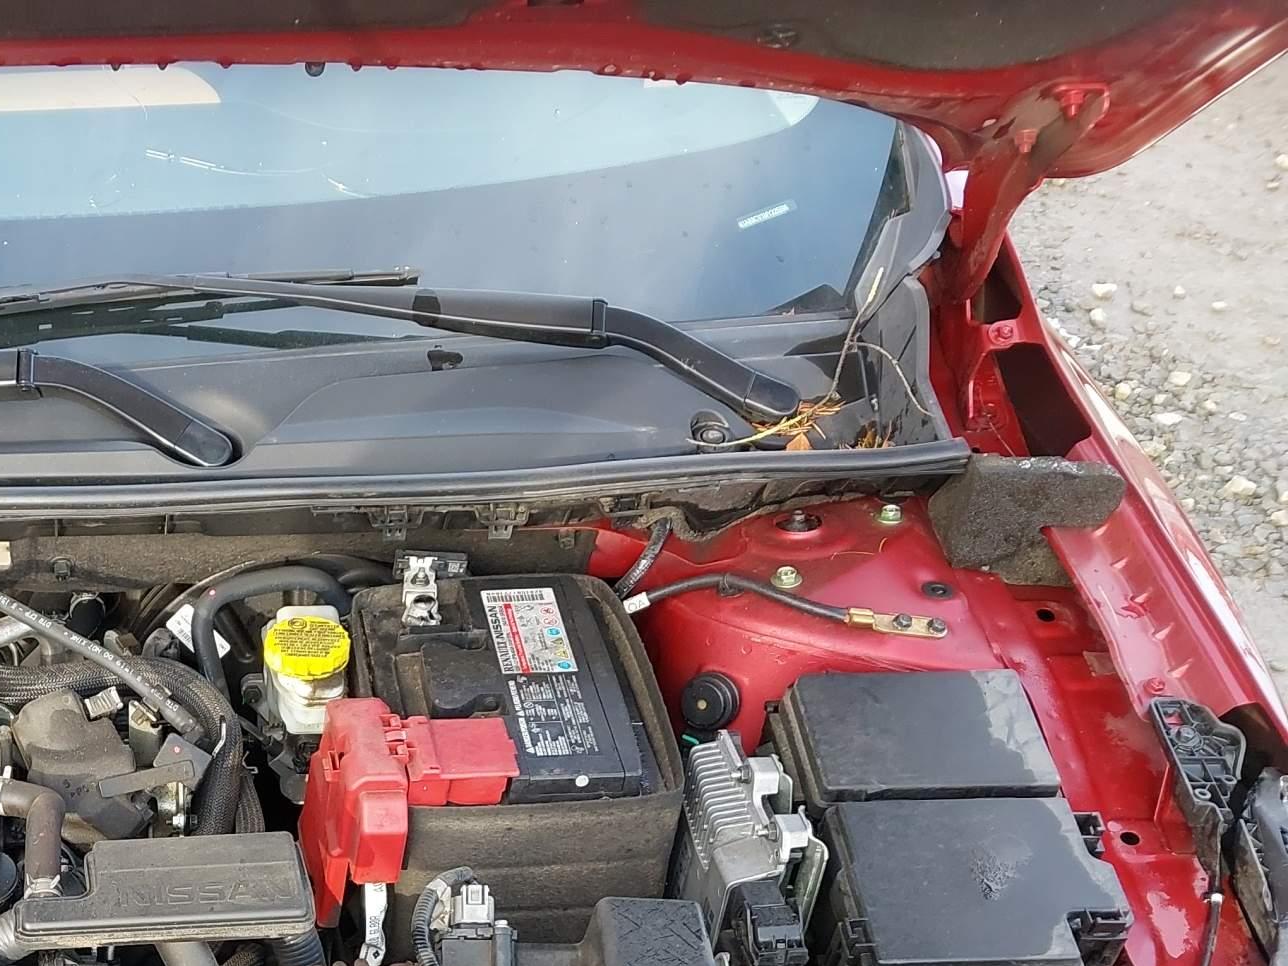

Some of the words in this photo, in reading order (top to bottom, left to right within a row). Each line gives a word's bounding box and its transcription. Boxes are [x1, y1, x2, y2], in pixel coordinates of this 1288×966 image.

[487, 605, 505, 639] NISSAN
[494, 638, 513, 672] RENAULT
[112, 878, 298, 907] NISSAN
